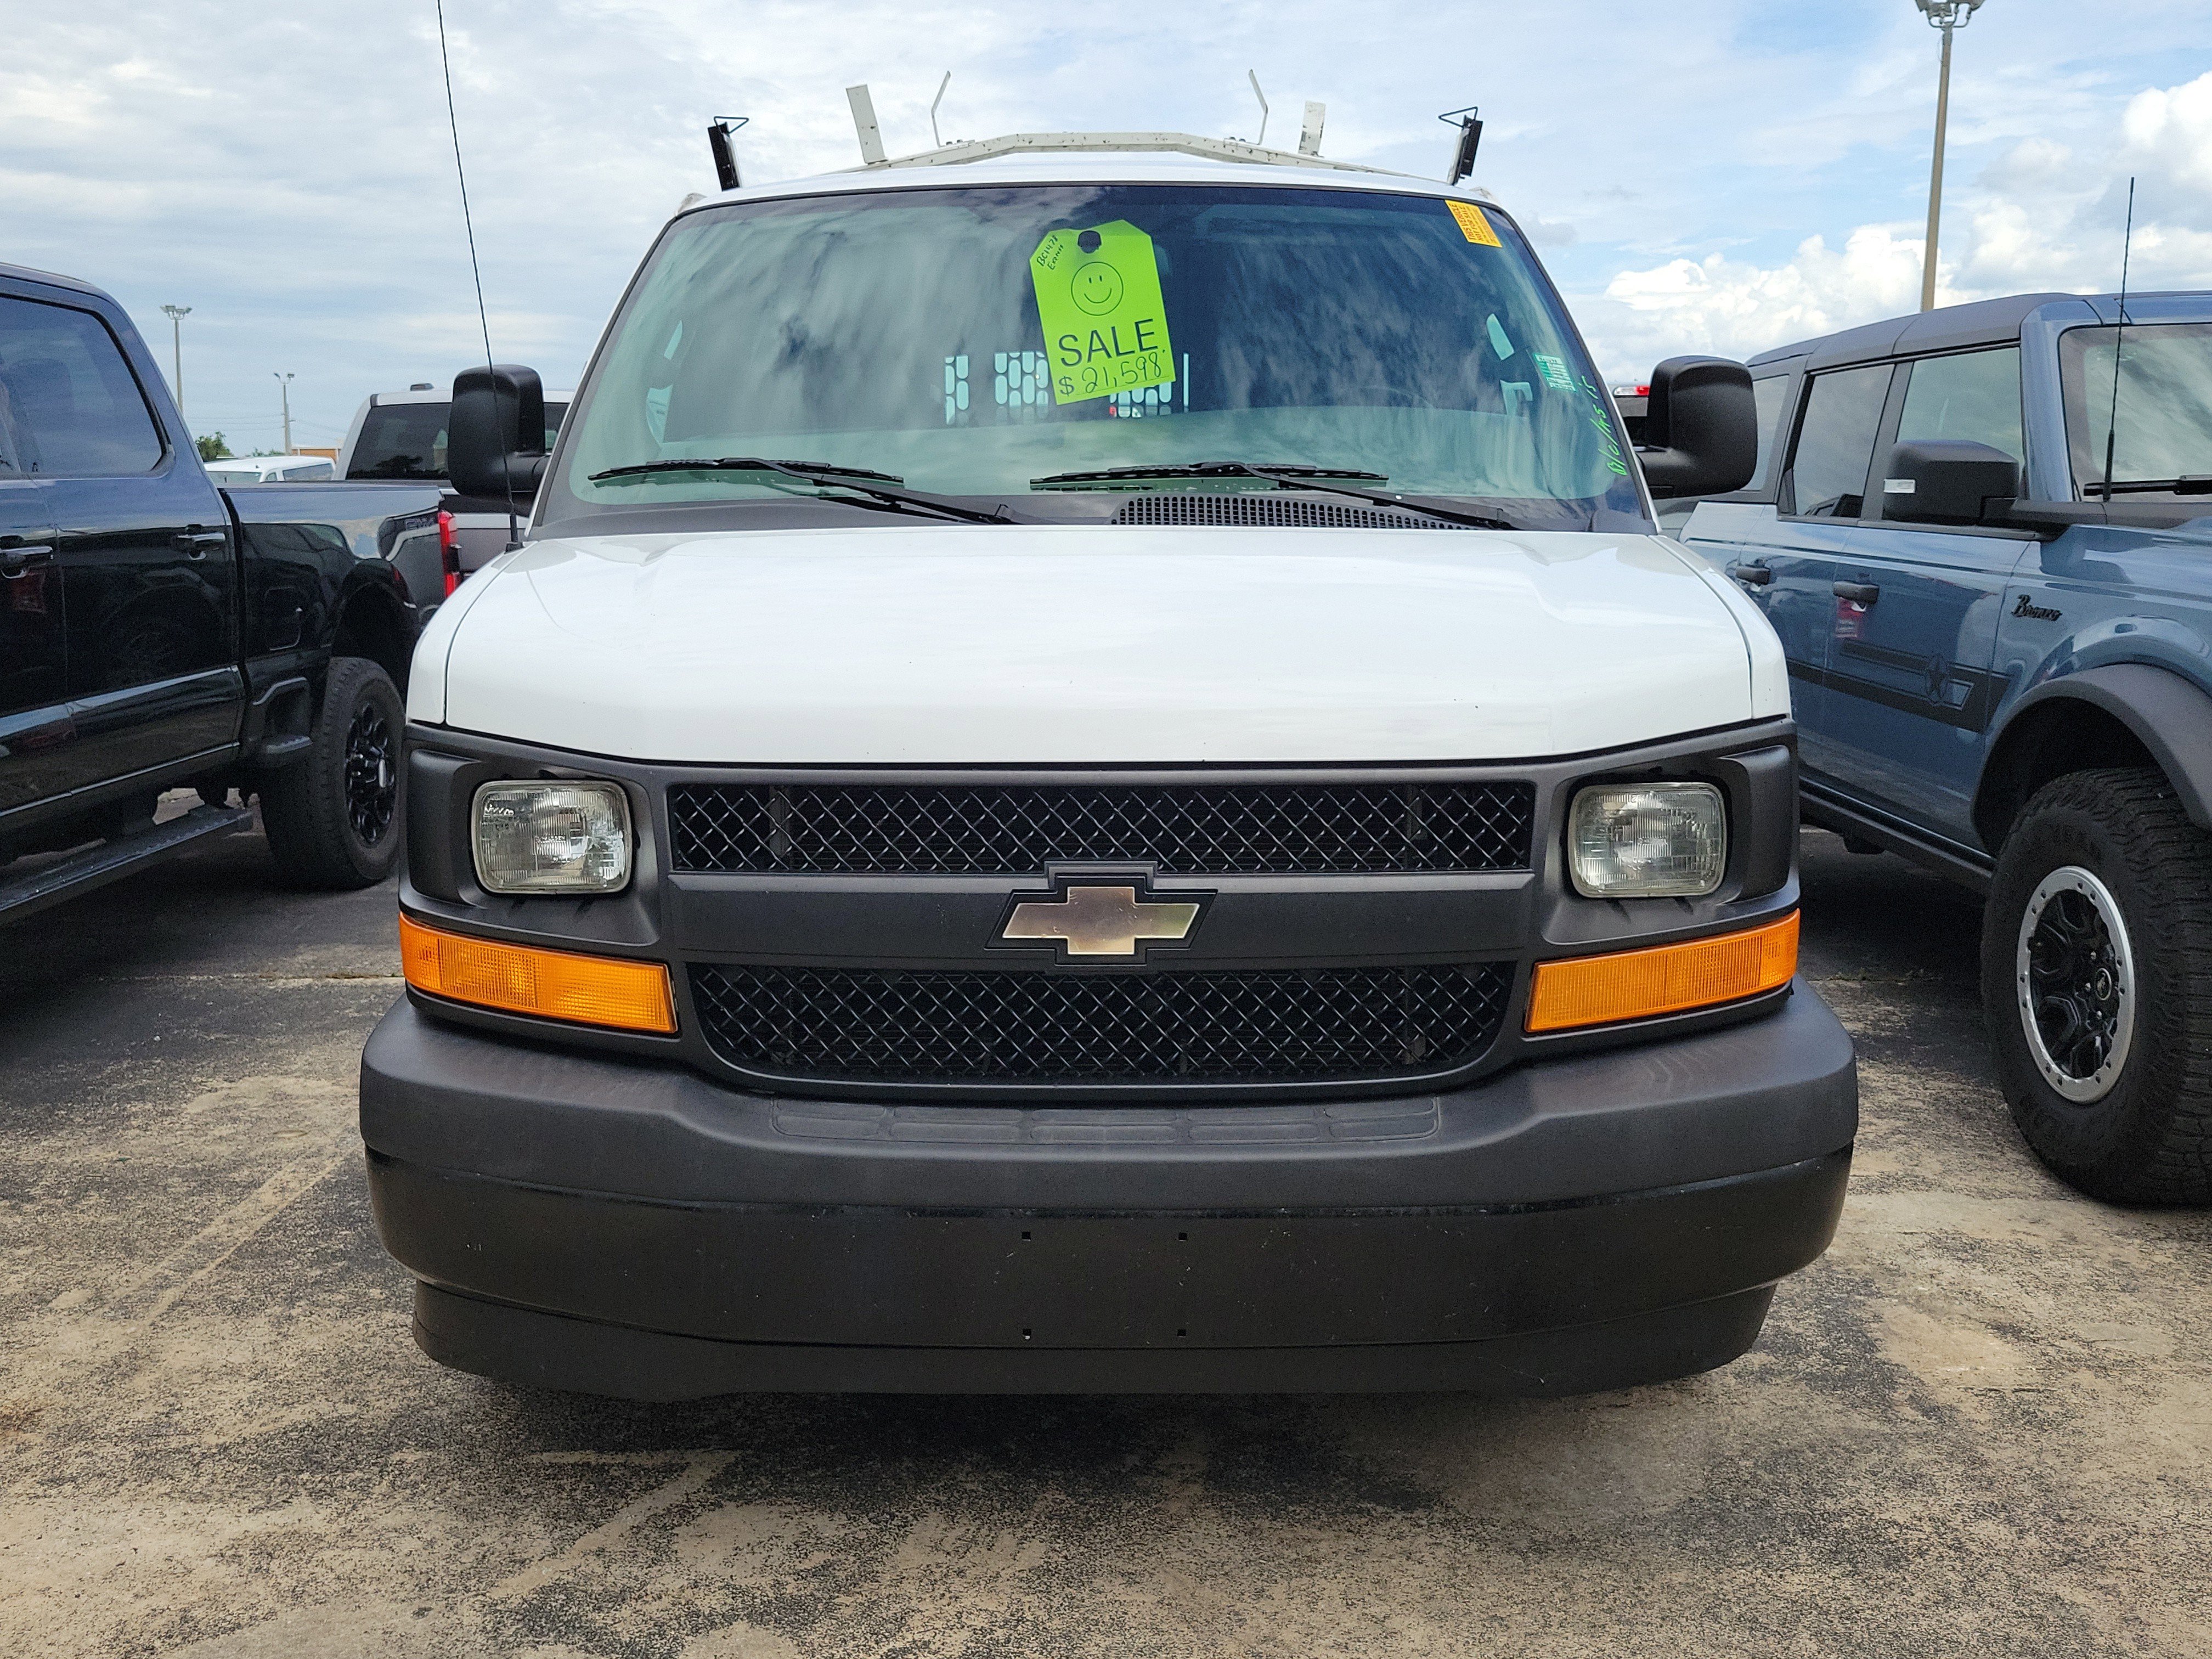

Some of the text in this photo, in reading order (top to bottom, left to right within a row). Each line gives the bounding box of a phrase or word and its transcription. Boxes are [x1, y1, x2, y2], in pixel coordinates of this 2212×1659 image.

[1448, 202, 1476, 240] THIS VEHICLE
[1458, 206, 1471, 219] SALE
[1058, 318, 1158, 366] SALE
[2010, 594, 2063, 622] Bronco
